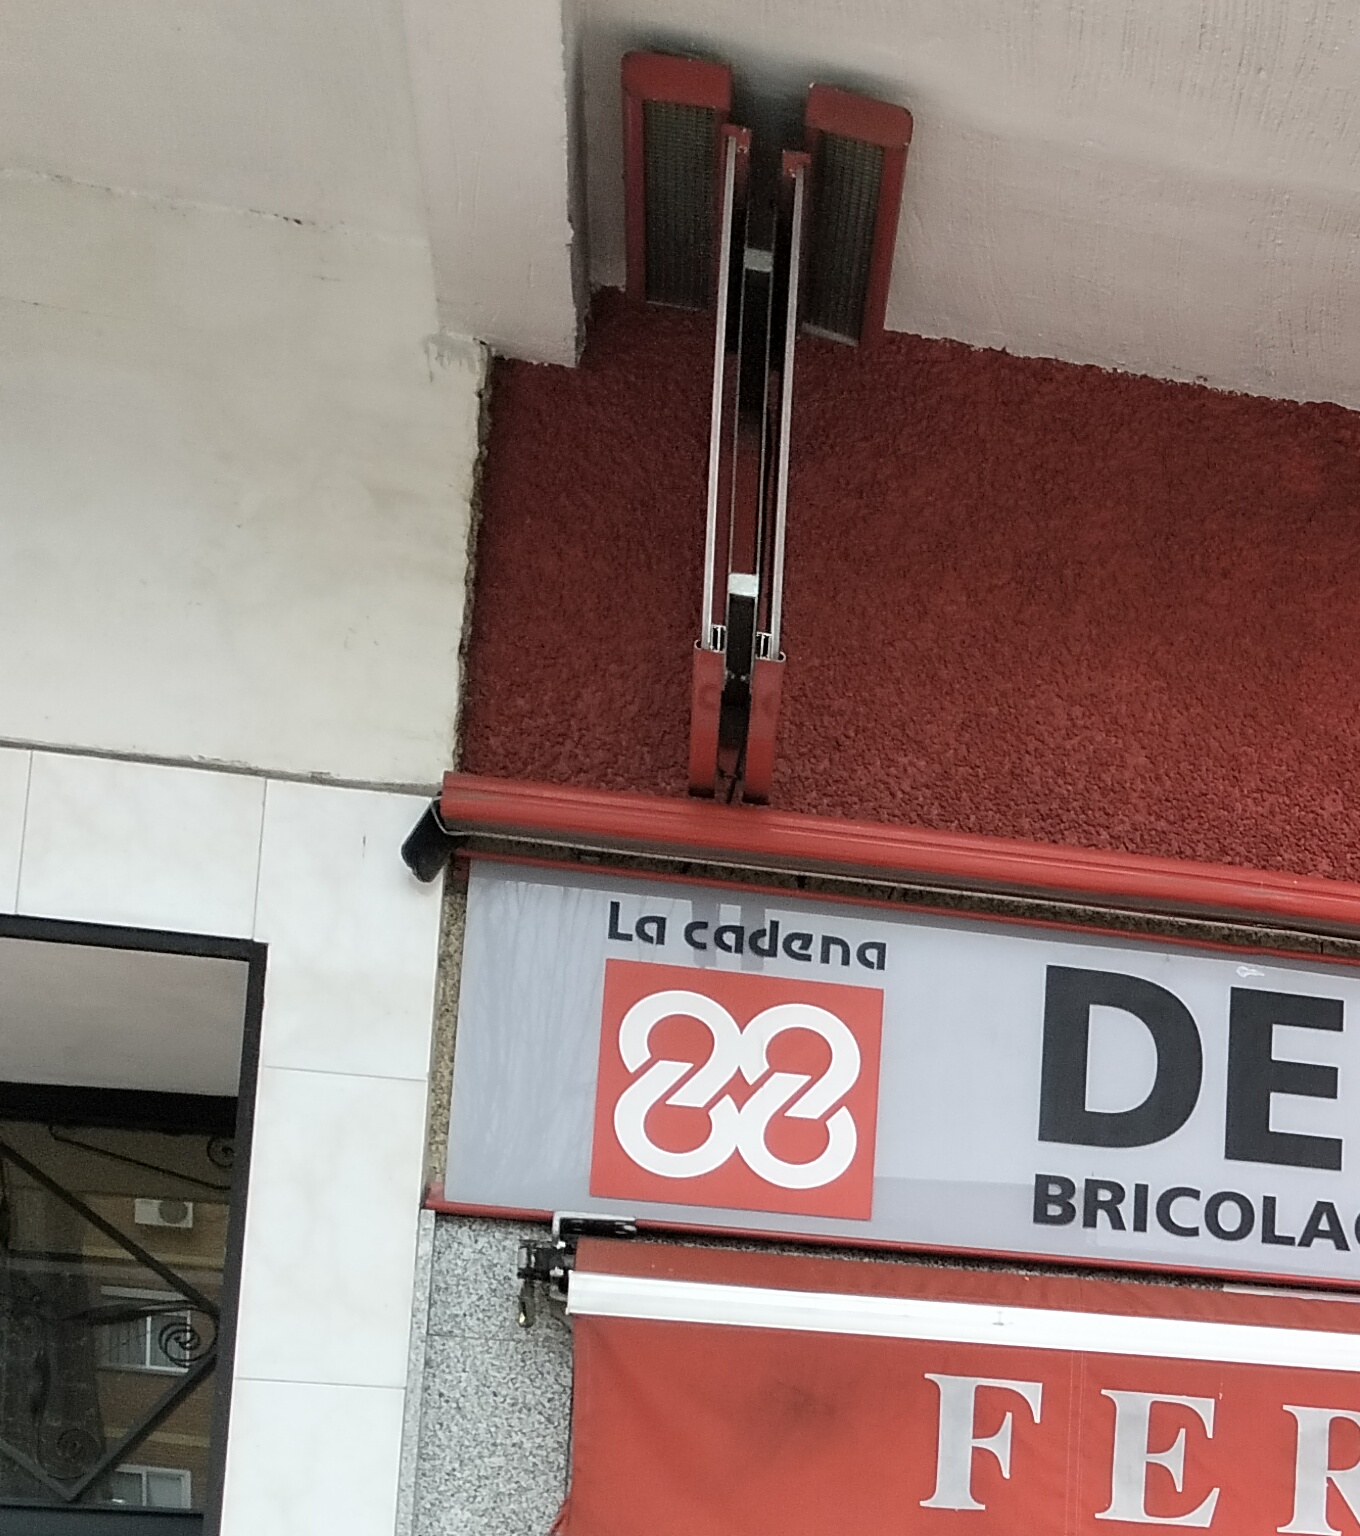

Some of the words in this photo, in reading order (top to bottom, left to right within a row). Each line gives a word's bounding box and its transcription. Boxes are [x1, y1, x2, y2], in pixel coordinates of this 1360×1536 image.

[607, 900, 666, 946] La
[684, 911, 887, 971] cadena
[1037, 964, 1346, 1172] DE
